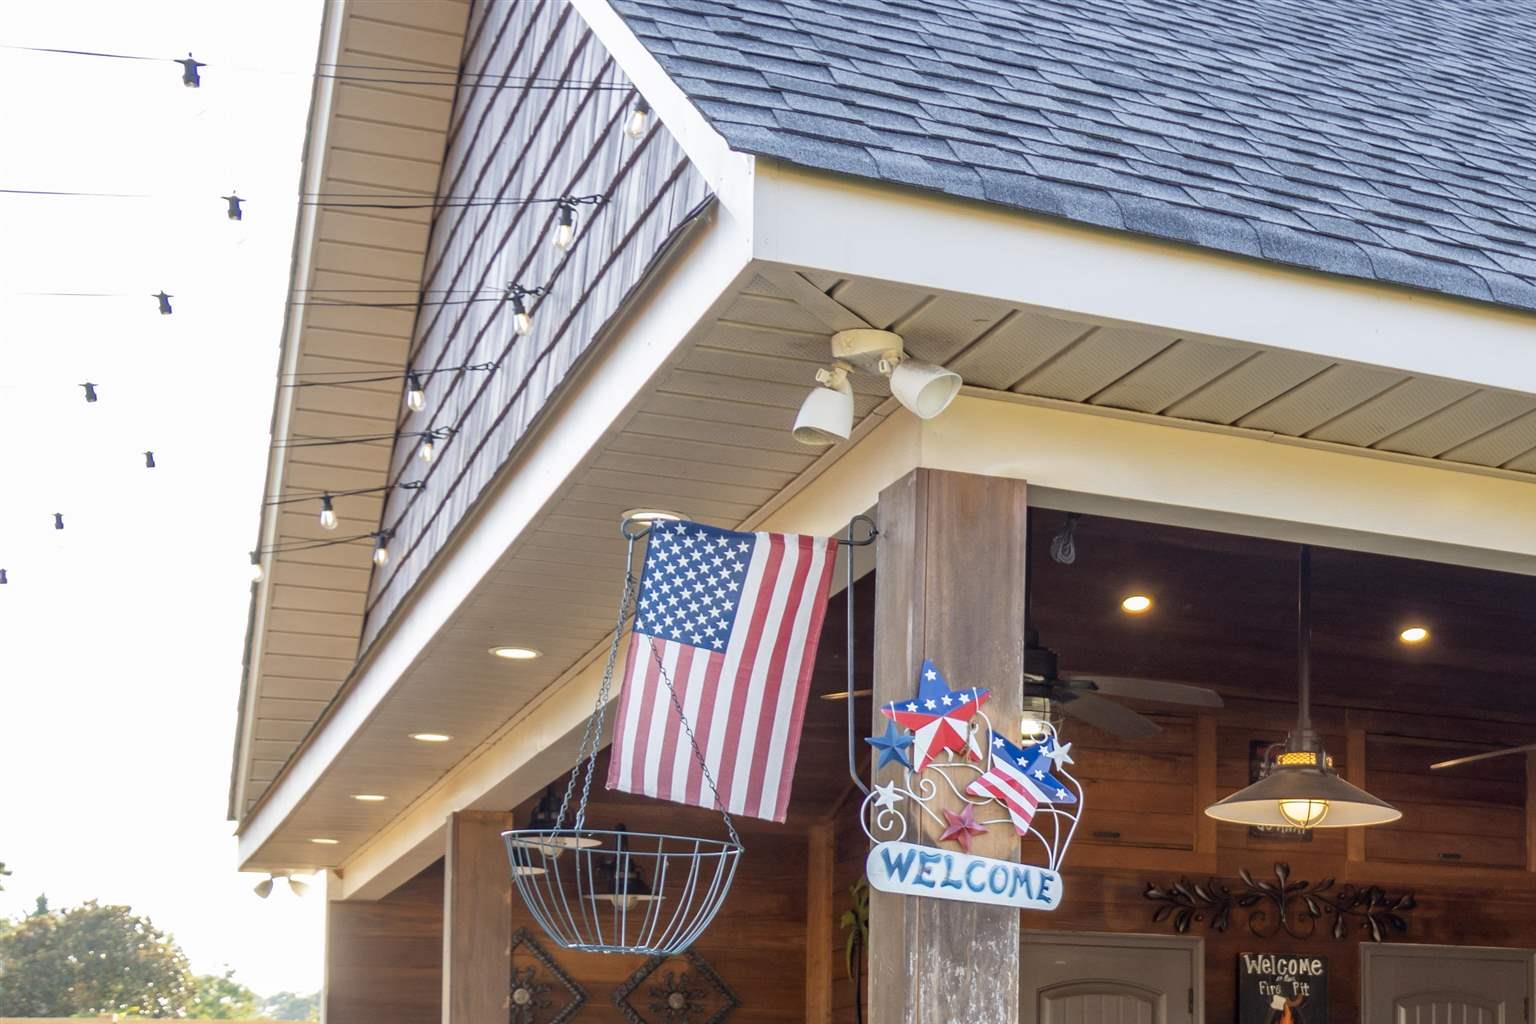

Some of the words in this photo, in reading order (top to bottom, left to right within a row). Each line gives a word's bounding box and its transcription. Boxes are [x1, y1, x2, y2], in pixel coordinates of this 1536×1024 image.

[881, 847, 1054, 904] WELCOME
[1244, 954, 1323, 975] Welcome
[1259, 981, 1281, 995] Fire
[1292, 981, 1310, 996] Pit
